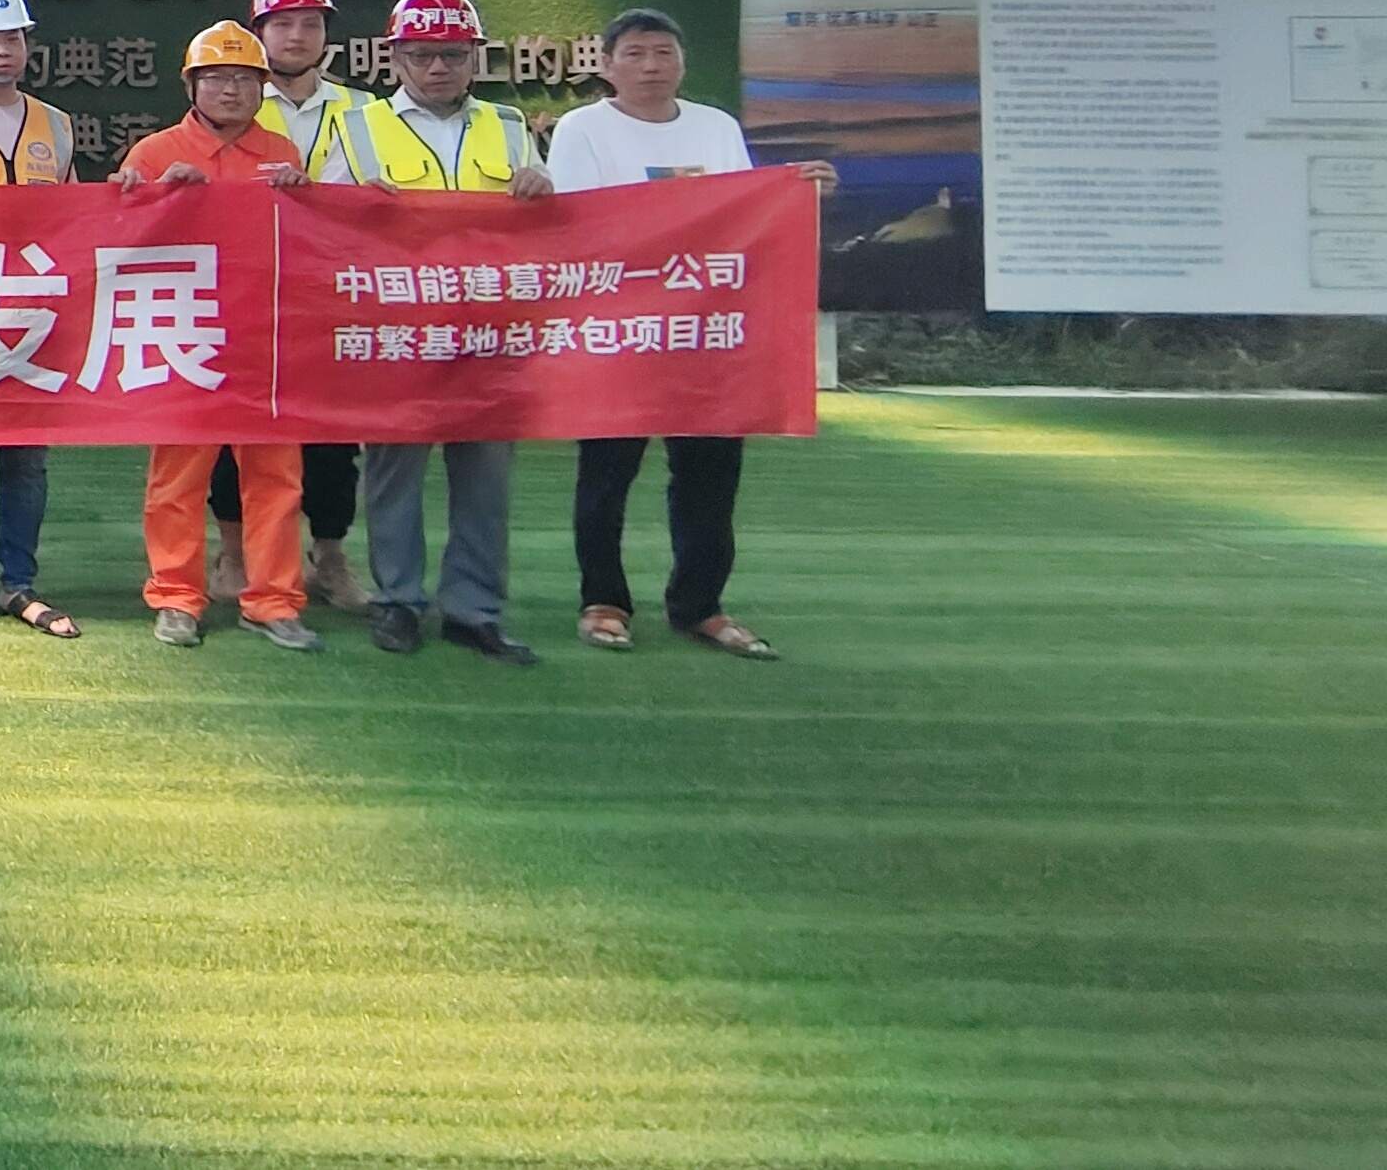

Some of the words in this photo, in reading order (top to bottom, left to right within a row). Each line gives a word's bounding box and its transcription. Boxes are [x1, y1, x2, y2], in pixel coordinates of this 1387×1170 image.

[333, 251, 747, 305] 中国能建葛洲坝一公司
[332, 310, 746, 363] 南繁基地总承包项目部
